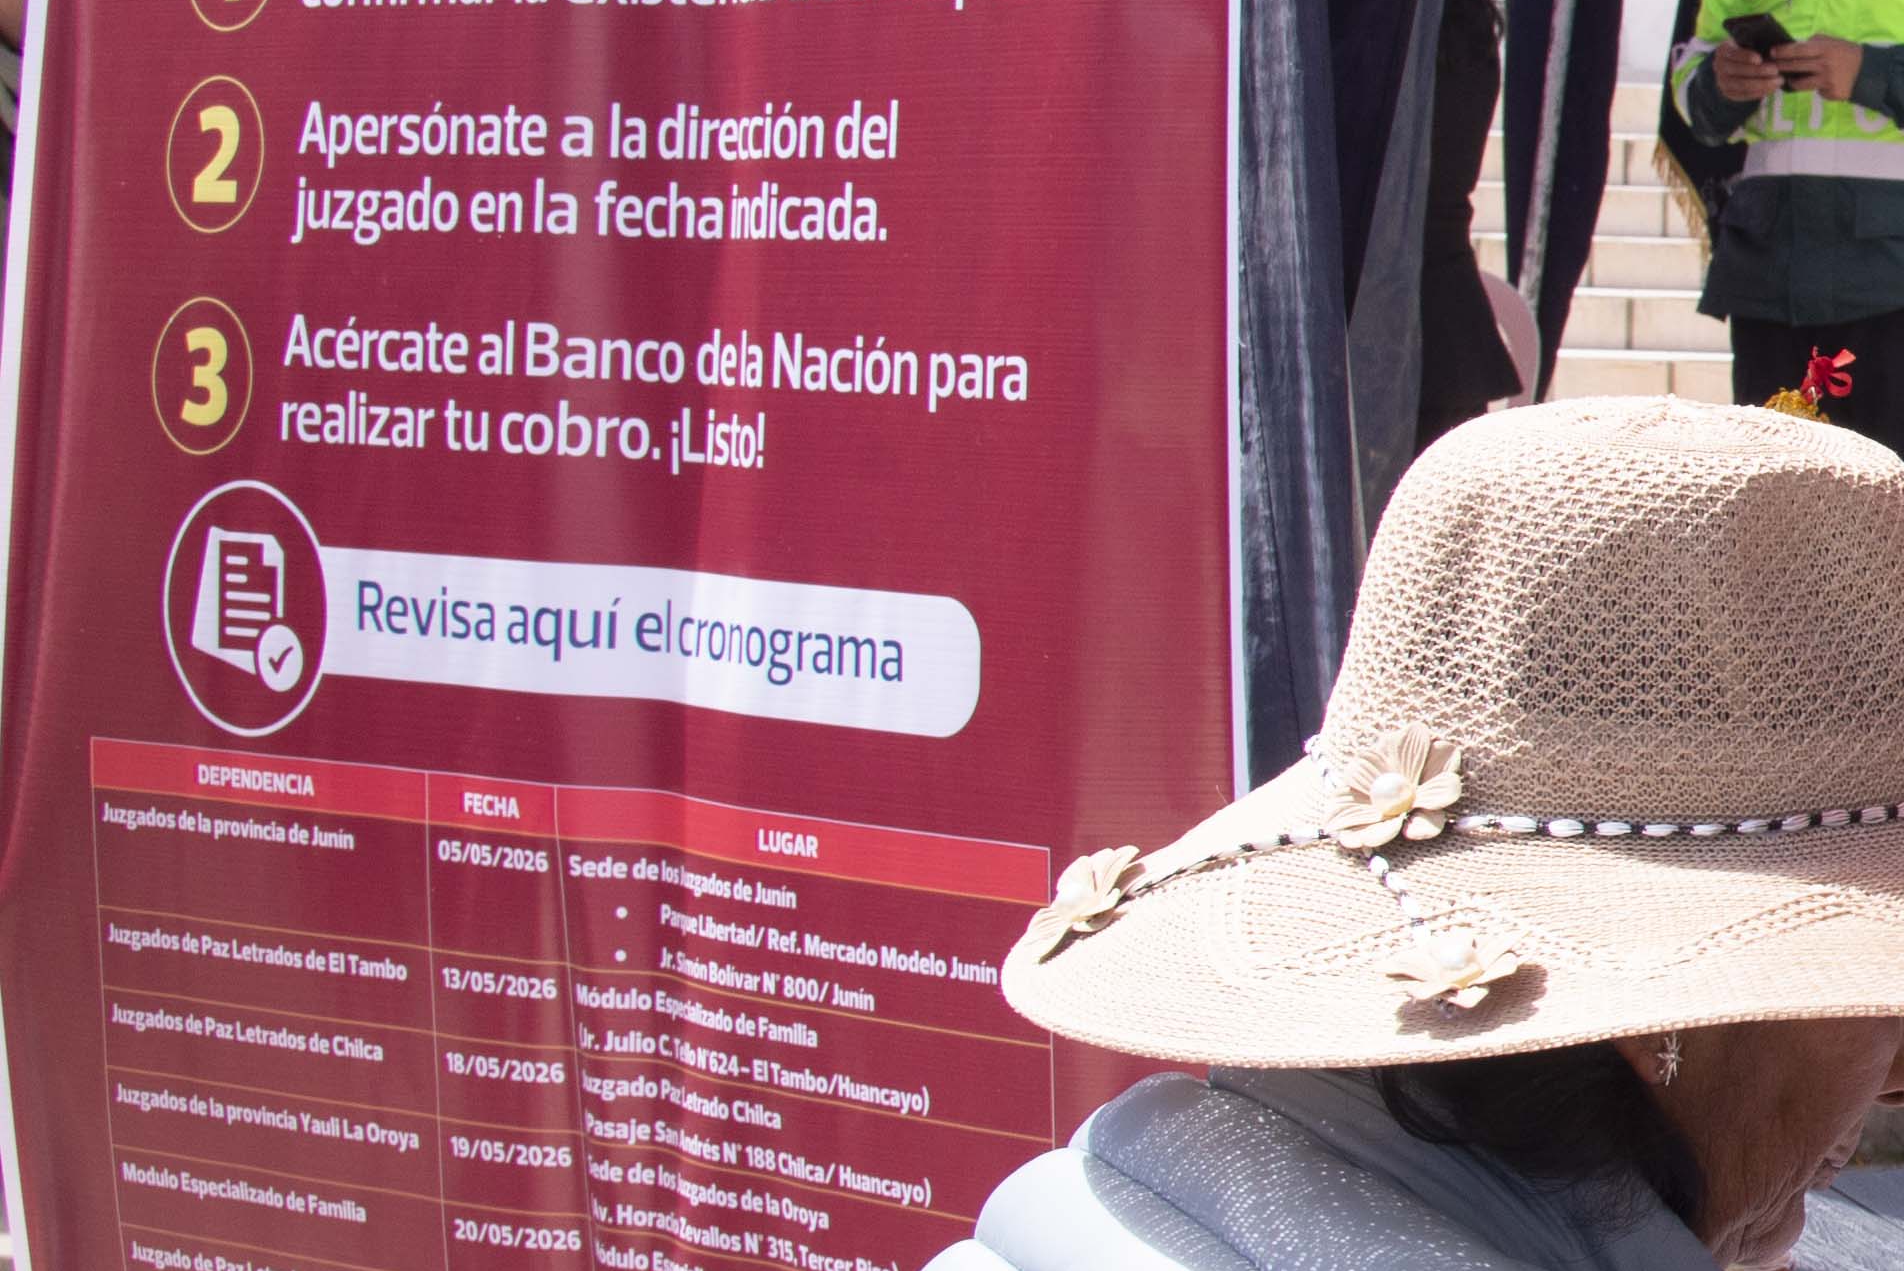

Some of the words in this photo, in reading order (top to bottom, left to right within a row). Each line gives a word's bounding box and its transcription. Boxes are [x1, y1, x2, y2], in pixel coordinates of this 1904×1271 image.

[193, 105, 240, 203] 2
[299, 101, 545, 169] Apersónate
[561, 114, 593, 156] a
[610, 102, 646, 158] la
[658, 103, 823, 160] dirección
[834, 100, 898, 159] del
[291, 176, 459, 245] juzgado
[470, 195, 522, 233] en
[534, 178, 577, 235] la
[595, 182, 723, 238] fecha
[730, 182, 887, 241] indicada.
[181, 327, 228, 426] 3
[284, 314, 468, 373] Acércate
[478, 320, 514, 375] al
[525, 322, 685, 383] Banco
[696, 328, 733, 386] de
[738, 330, 763, 387] la
[772, 333, 917, 396] Nación
[929, 352, 1028, 413] para
[281, 391, 435, 448] realizar
[445, 399, 489, 452] tu
[500, 400, 660, 460] cobro.
[671, 407, 765, 474] ¡Listo!
[358, 580, 496, 642] Revisa
[506, 597, 620, 662] aquí
[635, 599, 671, 653] el
[679, 615, 904, 685] cronograma
[197, 763, 314, 797] DEPENDENCIA
[463, 791, 519, 819] FECHA
[102, 801, 176, 832] Juzgados
[178, 808, 196, 830] de
[198, 810, 212, 833] la
[214, 815, 285, 845] provincia
[289, 822, 308, 844] de
[311, 825, 355, 851] Junín
[758, 829, 818, 859] LUGAR
[437, 839, 549, 873] 05/05/2026
[442, 966, 557, 1001] 13/05/2026
[445, 1050, 565, 1086] 18/05/2026
[450, 1134, 573, 1169] 19/05/2026
[122, 1162, 178, 1191] Modulo
[181, 1168, 283, 1210] Especializado
[287, 1193, 305, 1214] de
[307, 1195, 366, 1224] Familia
[454, 1218, 582, 1253] 20/05/2026
